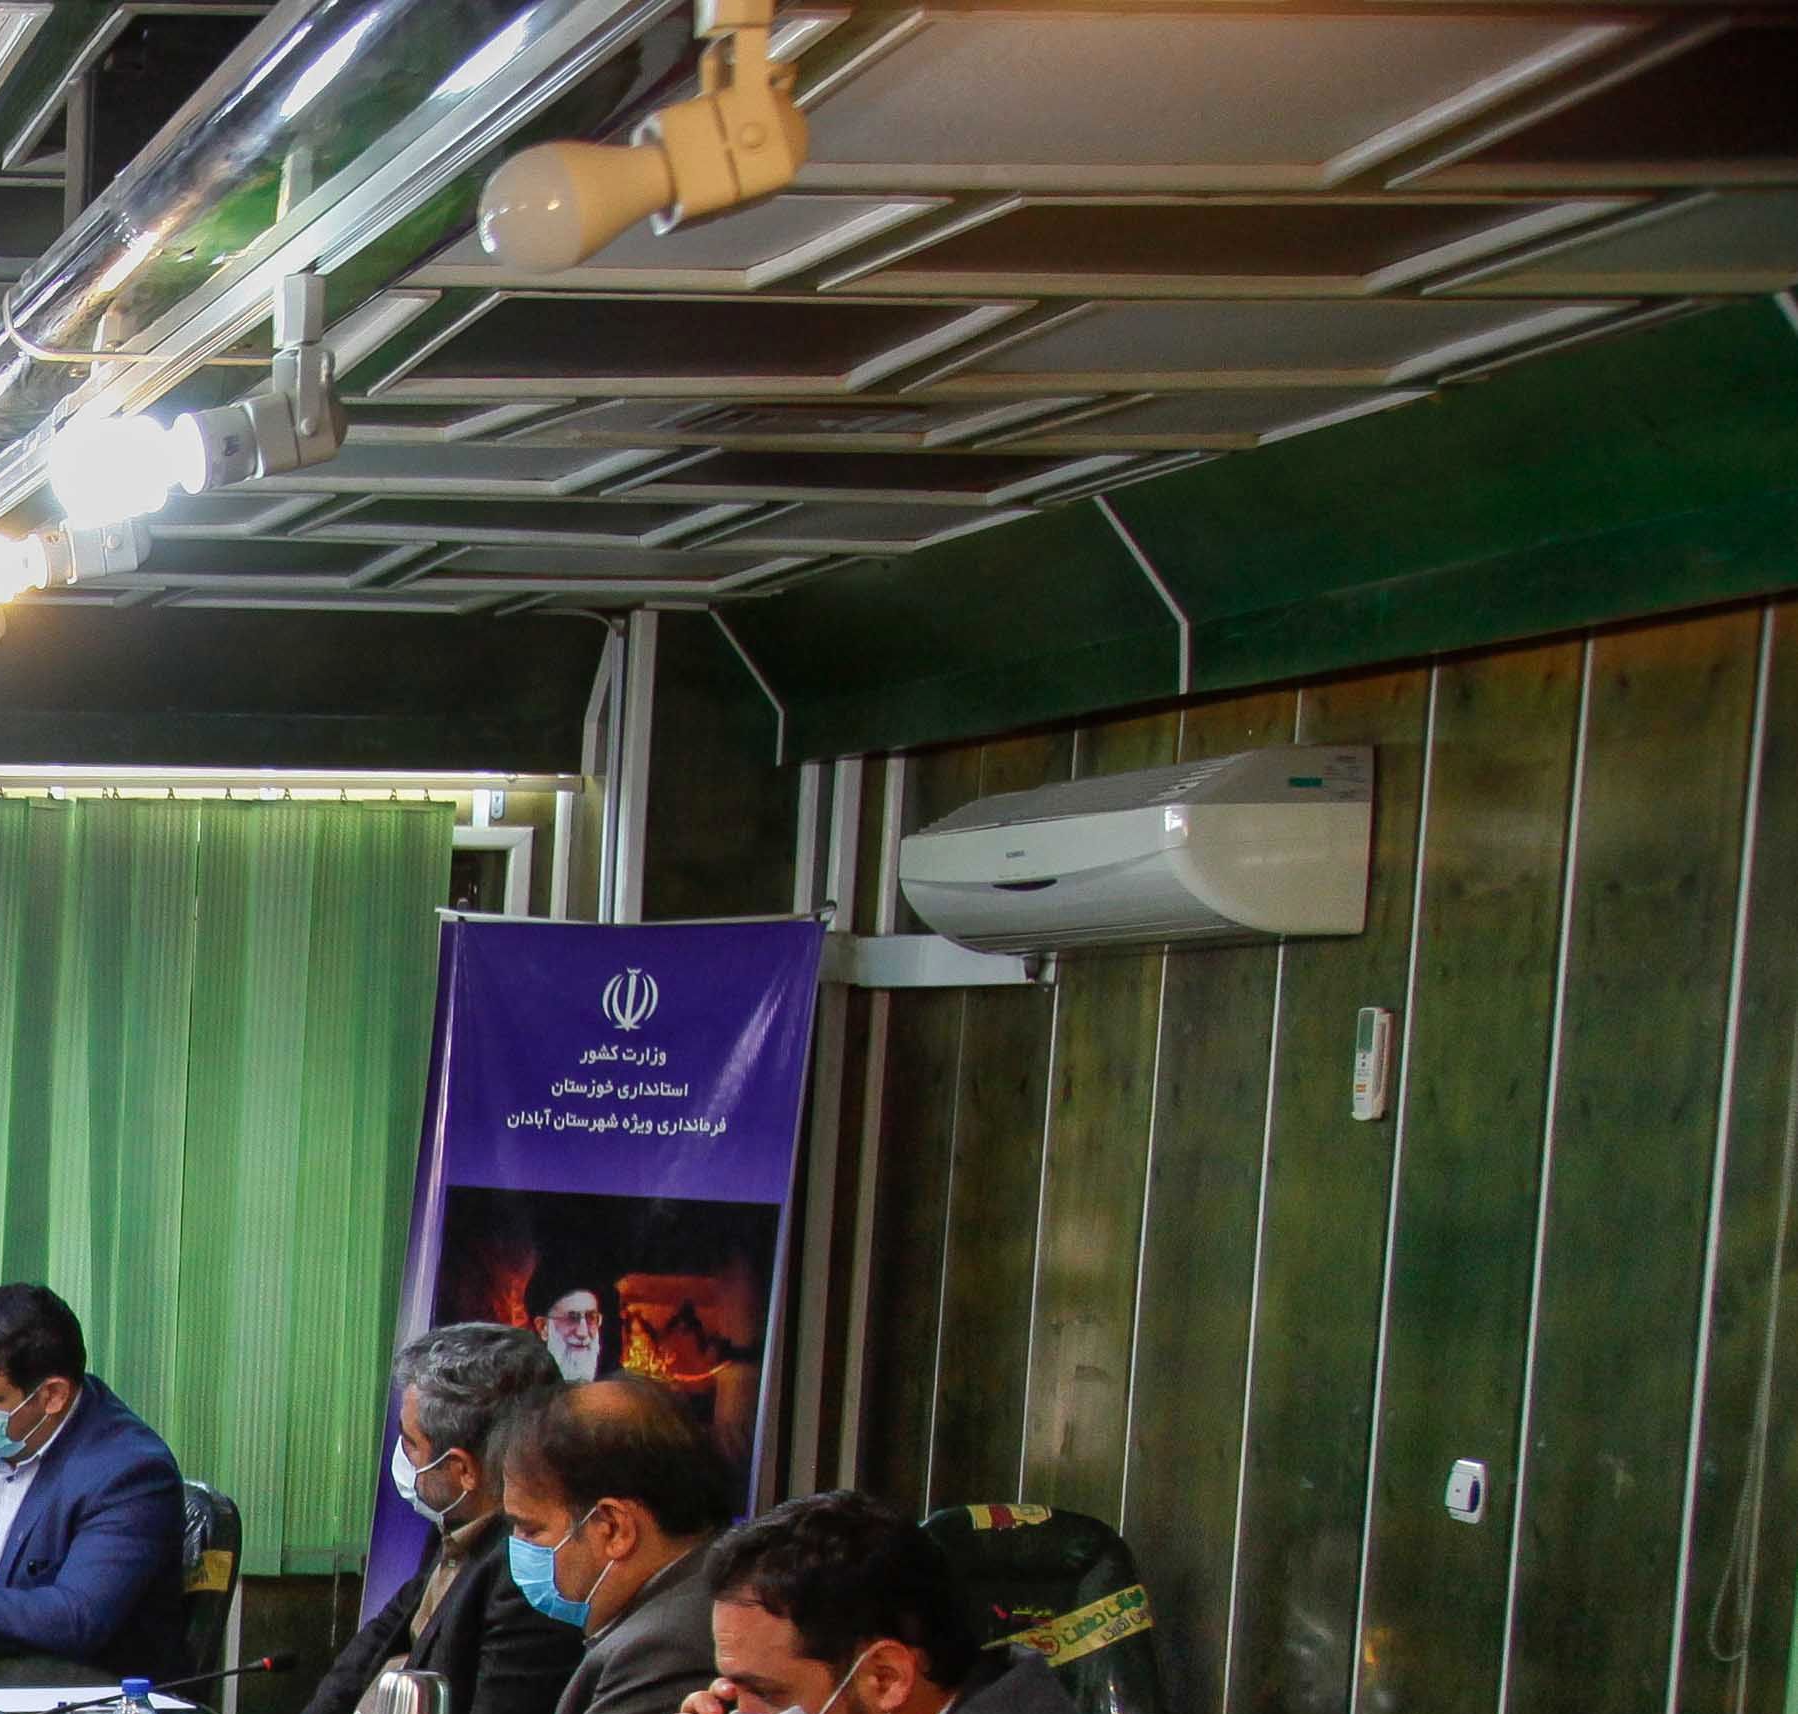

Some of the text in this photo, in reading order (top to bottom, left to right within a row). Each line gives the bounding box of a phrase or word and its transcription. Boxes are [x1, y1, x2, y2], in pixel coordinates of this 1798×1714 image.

[579, 1044, 667, 1066] وزارت کشور
[551, 1078, 689, 1099] استانداری خوزستان
[507, 1108, 727, 1137] فرمانداری ویژه شهرستان آبادان
